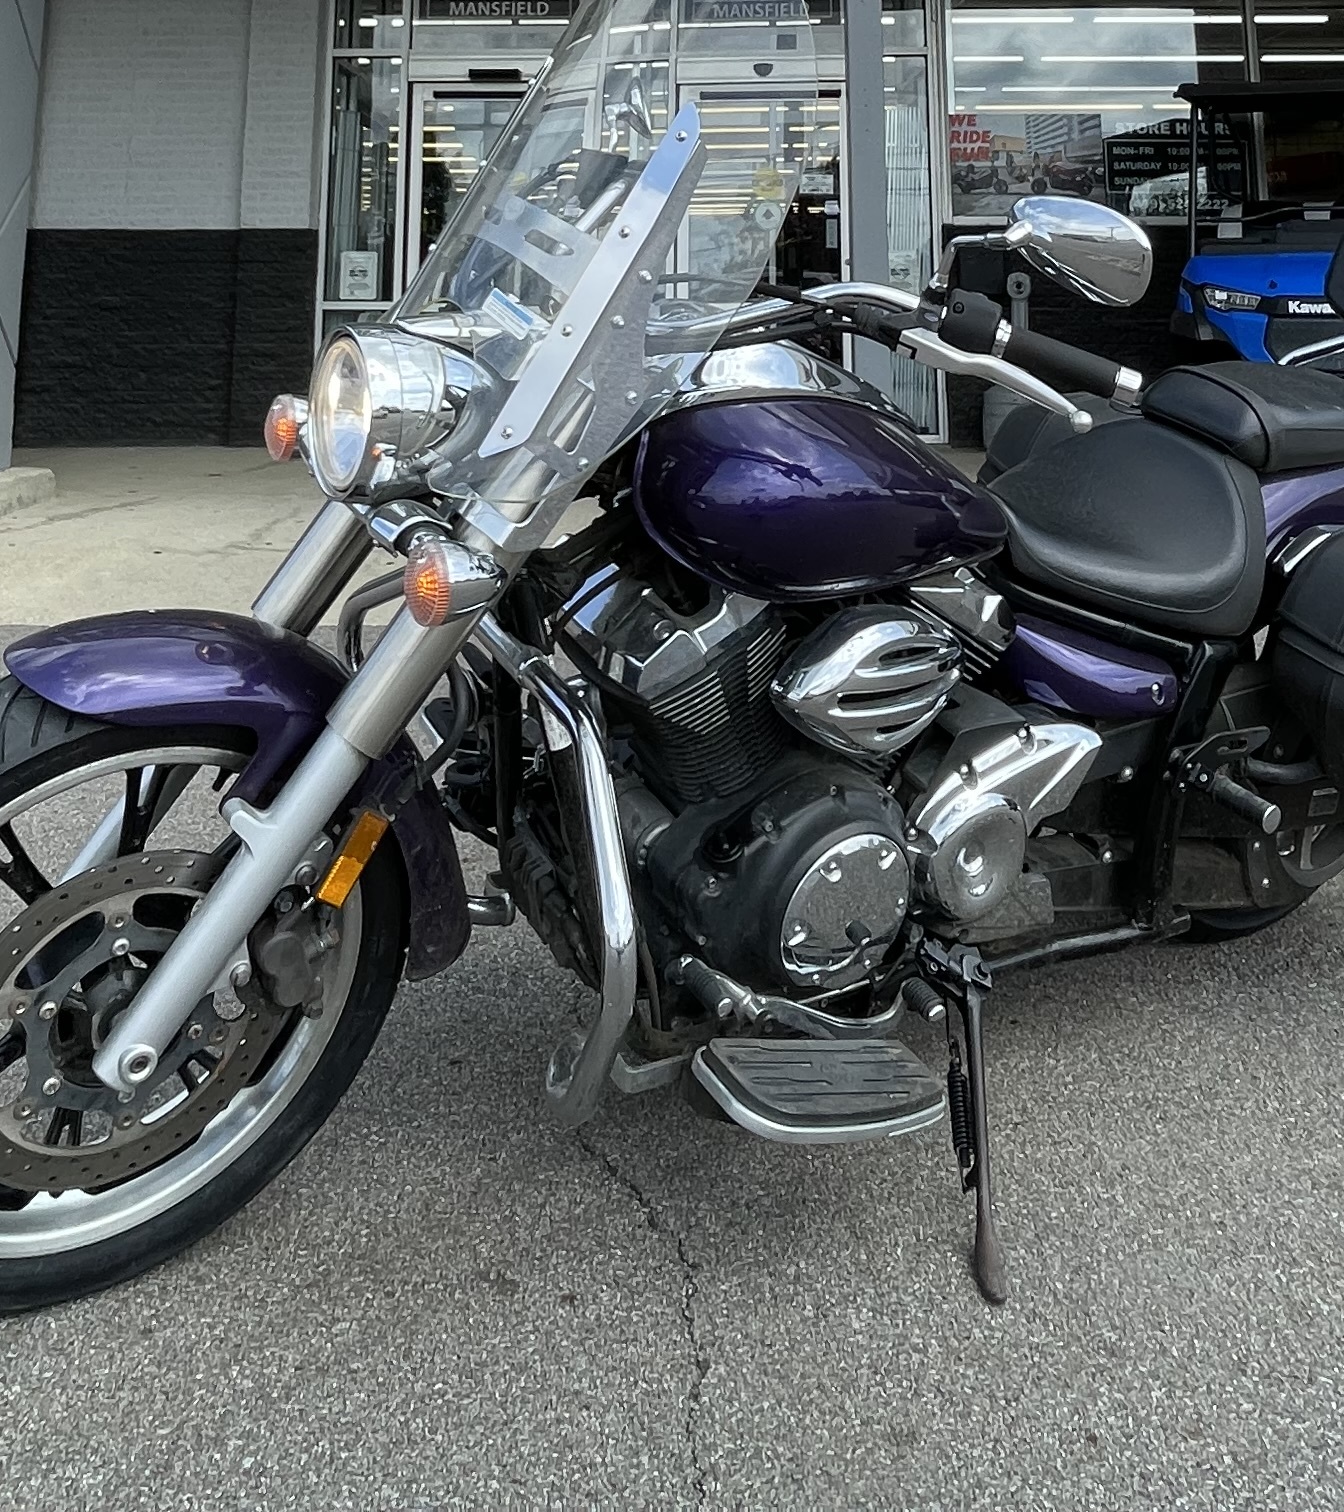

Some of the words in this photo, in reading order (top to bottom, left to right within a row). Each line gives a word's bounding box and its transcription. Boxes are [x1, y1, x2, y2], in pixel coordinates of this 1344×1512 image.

[449, 1, 550, 16] MANSFIELD
[713, 1, 810, 19] MANSFIELD
[948, 113, 977, 127] WE
[1114, 122, 1171, 135] STORE
[949, 129, 992, 144] RIDE
[1113, 162, 1162, 171] SATURDAY
[1287, 299, 1336, 315] Kawa
